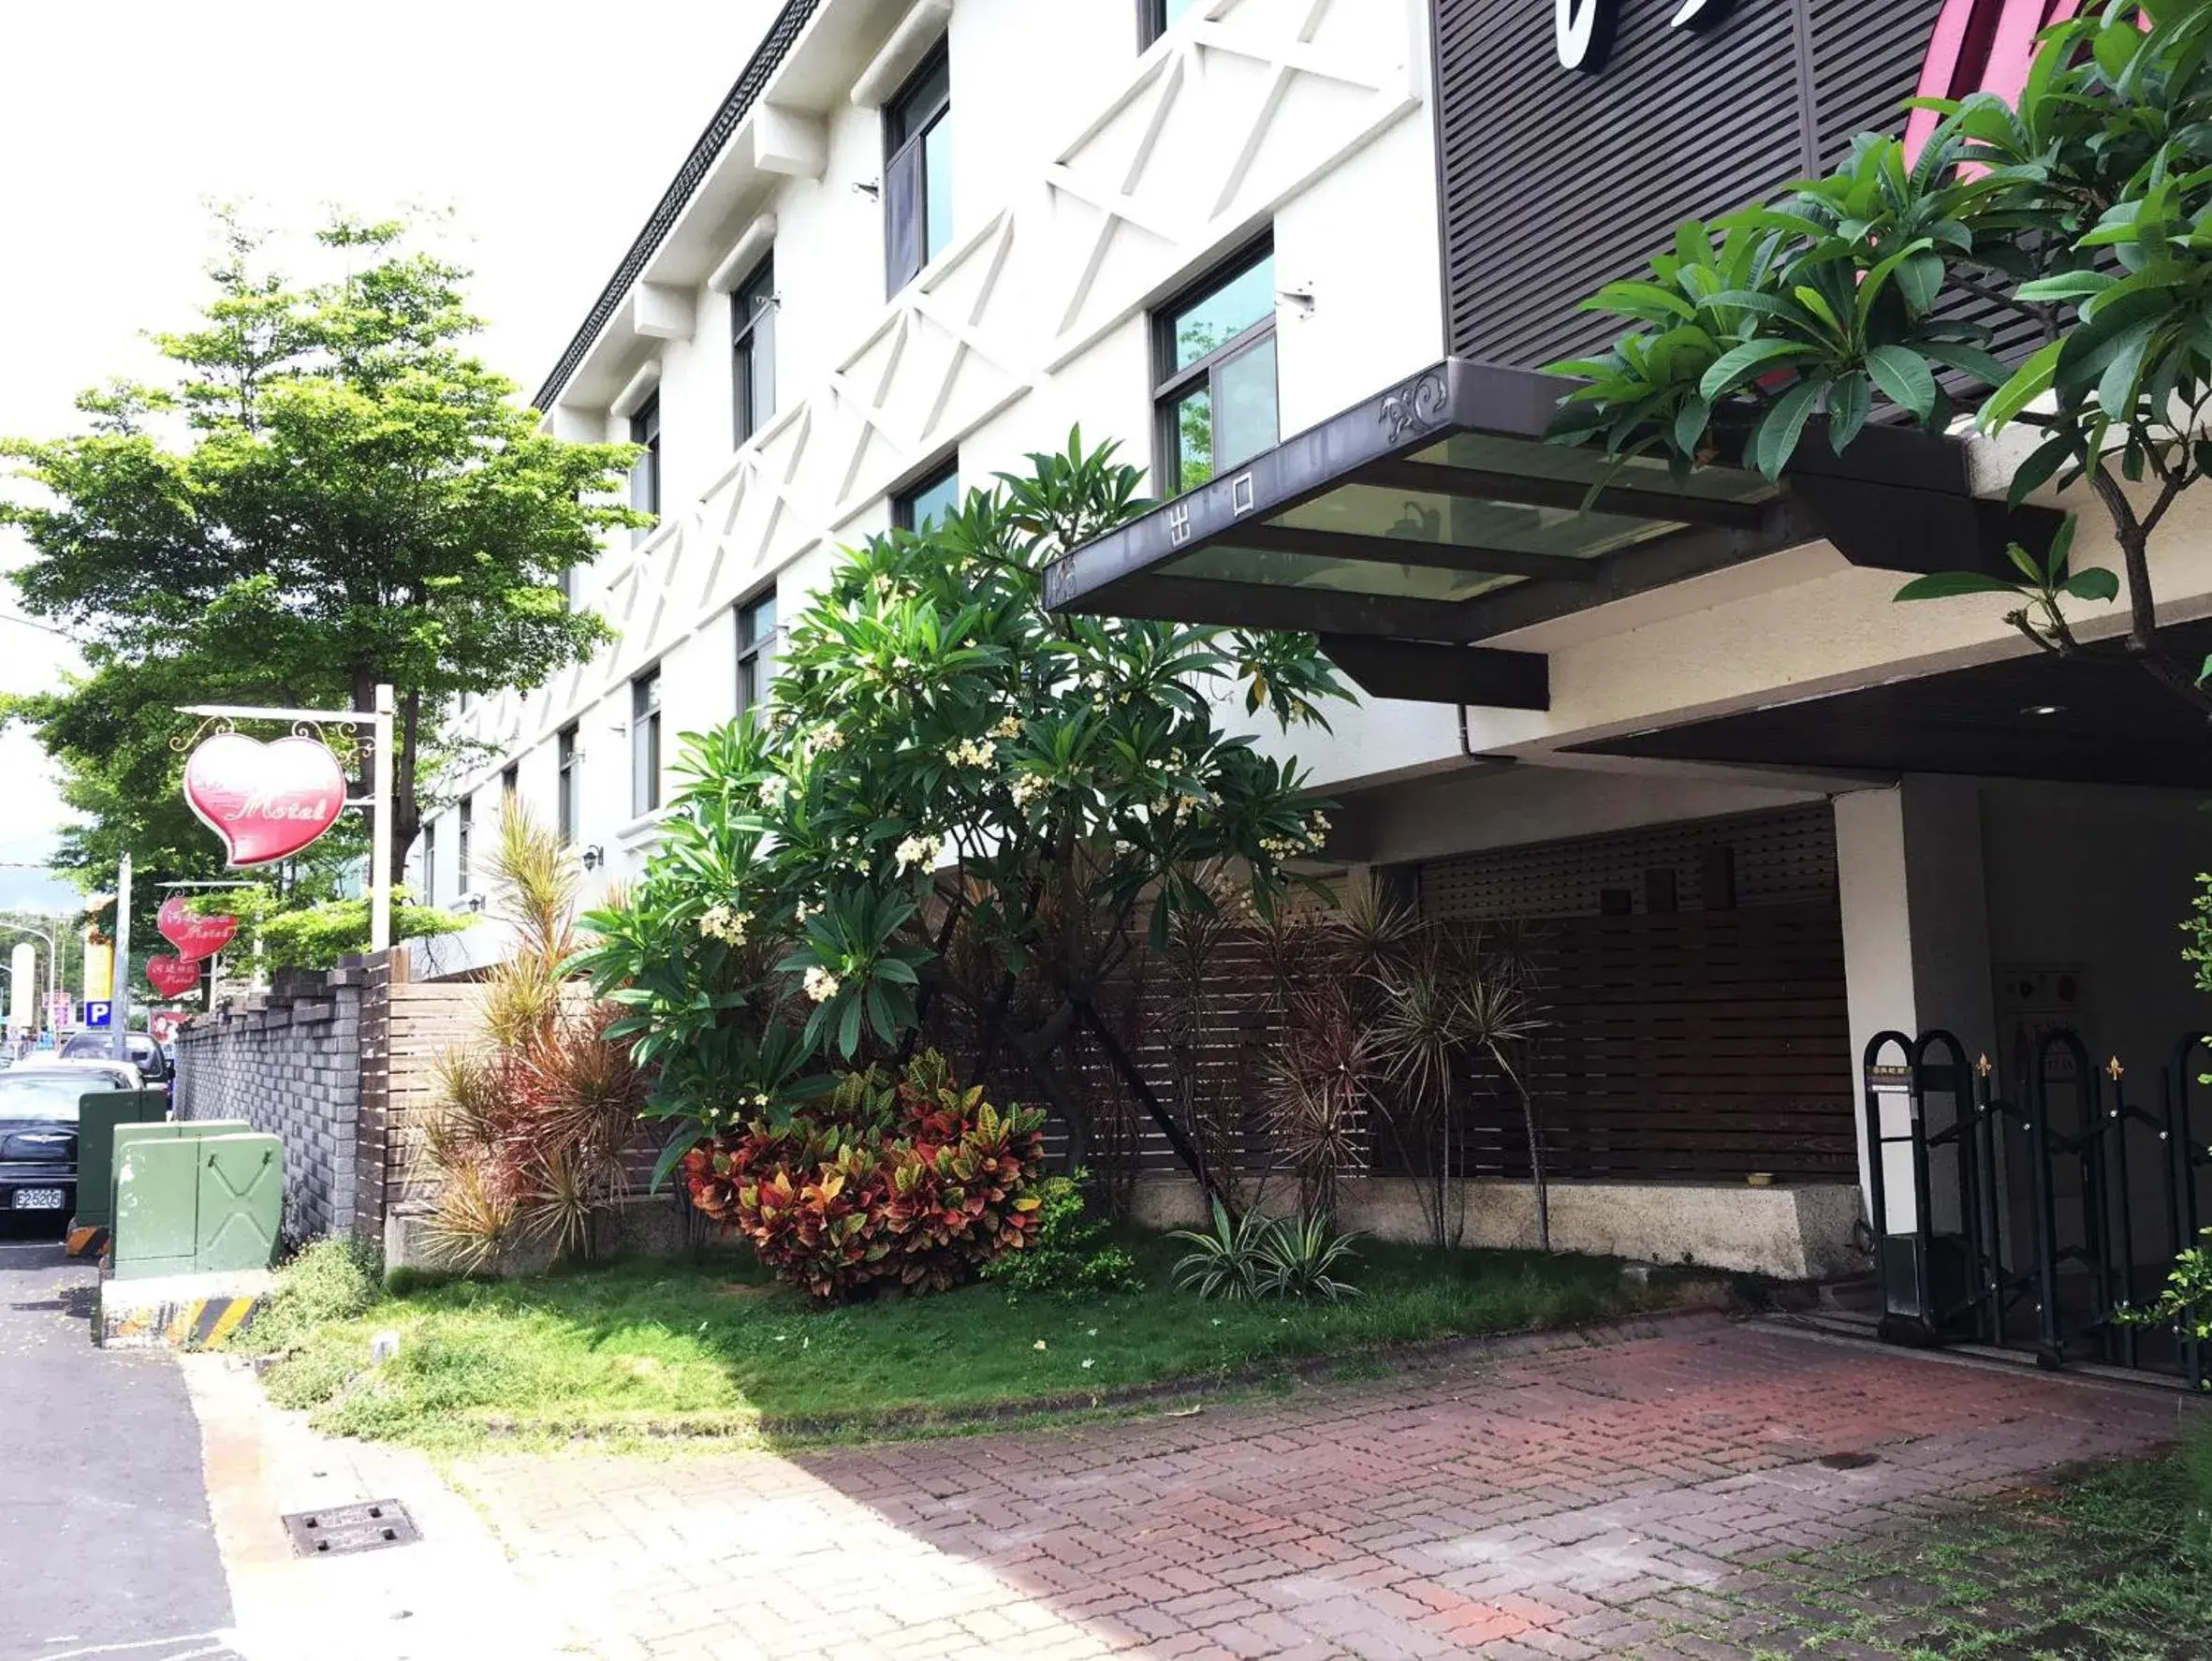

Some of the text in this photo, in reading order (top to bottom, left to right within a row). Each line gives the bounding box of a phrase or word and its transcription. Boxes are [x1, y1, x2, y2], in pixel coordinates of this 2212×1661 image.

[1170, 471, 1253, 547] 出口
[225, 797, 327, 821] Motel
[91, 1004, 109, 1022] P
